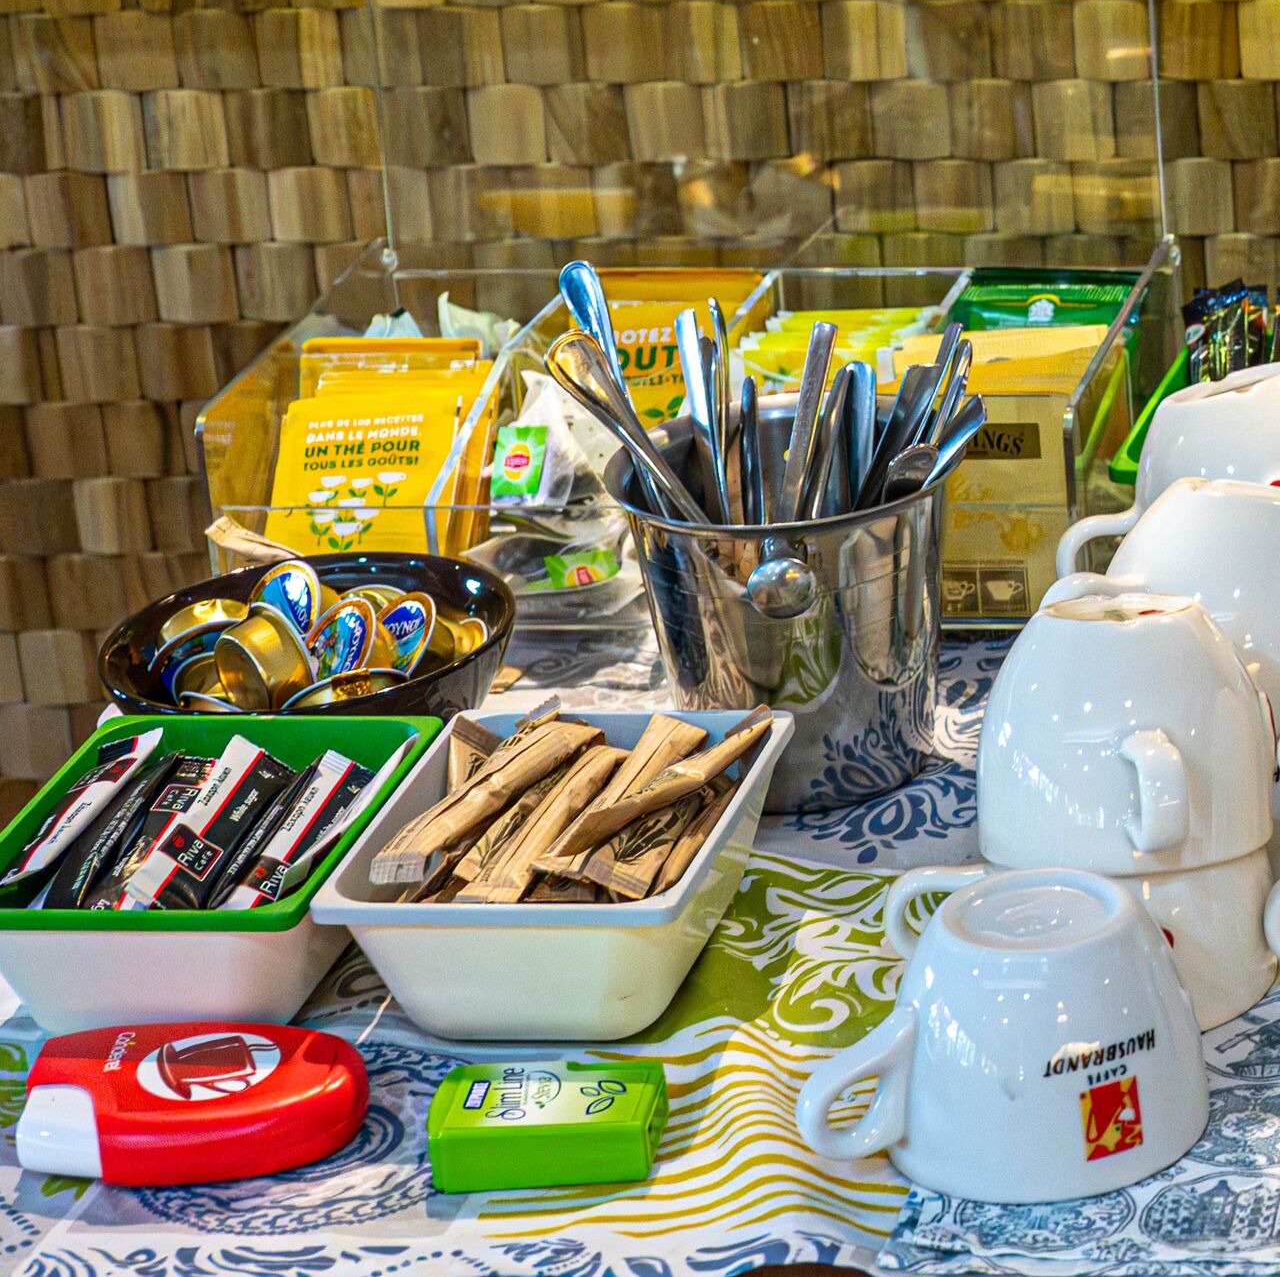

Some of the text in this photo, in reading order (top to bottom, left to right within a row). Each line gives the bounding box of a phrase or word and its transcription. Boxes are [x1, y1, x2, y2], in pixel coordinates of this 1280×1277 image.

[304, 439, 421, 459] UN THÉ POUR
[305, 429, 345, 444] DANS
[348, 430, 364, 441] LE
[303, 453, 419, 472] TOUS LES GOÛTS!
[172, 787, 200, 810] Riva
[177, 838, 205, 867] Riva
[259, 863, 288, 894] Riva
[1043, 1029, 1156, 1077] HAUSBRANDT
[485, 1068, 526, 1120] Slim Line
